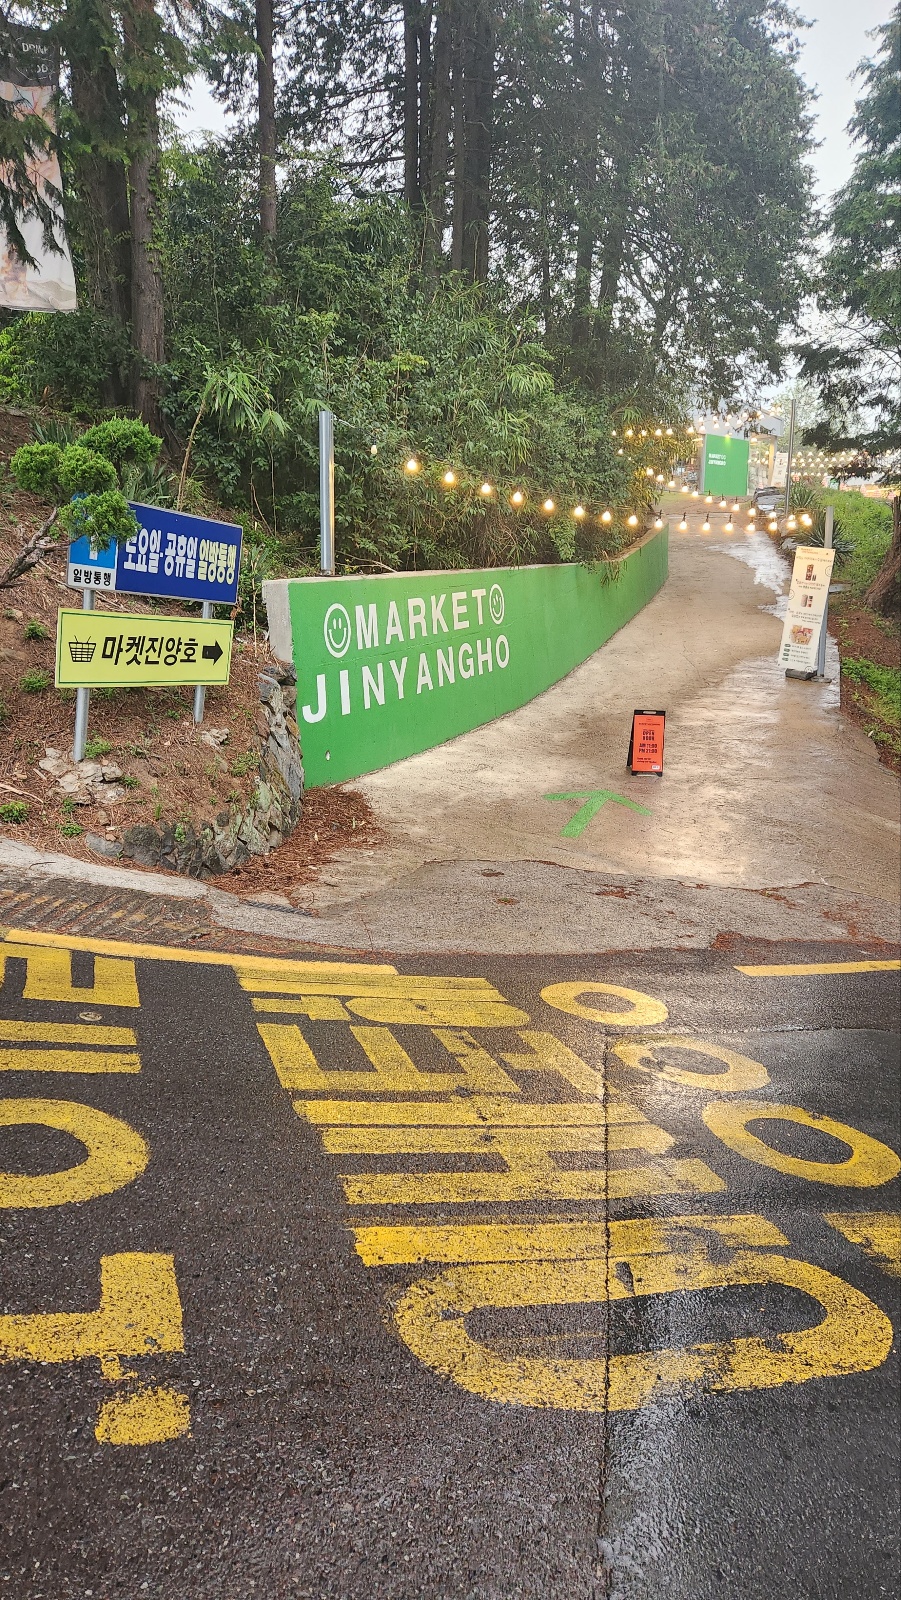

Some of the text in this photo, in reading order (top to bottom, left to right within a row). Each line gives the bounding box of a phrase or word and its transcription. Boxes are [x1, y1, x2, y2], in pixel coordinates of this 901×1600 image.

[73, 569, 112, 587] 일방통행
[197, 539, 237, 585] 일방통행
[355, 588, 487, 650] MARKET
[101, 634, 199, 666] 마켓진양호
[302, 634, 510, 724] JINYANGHO
